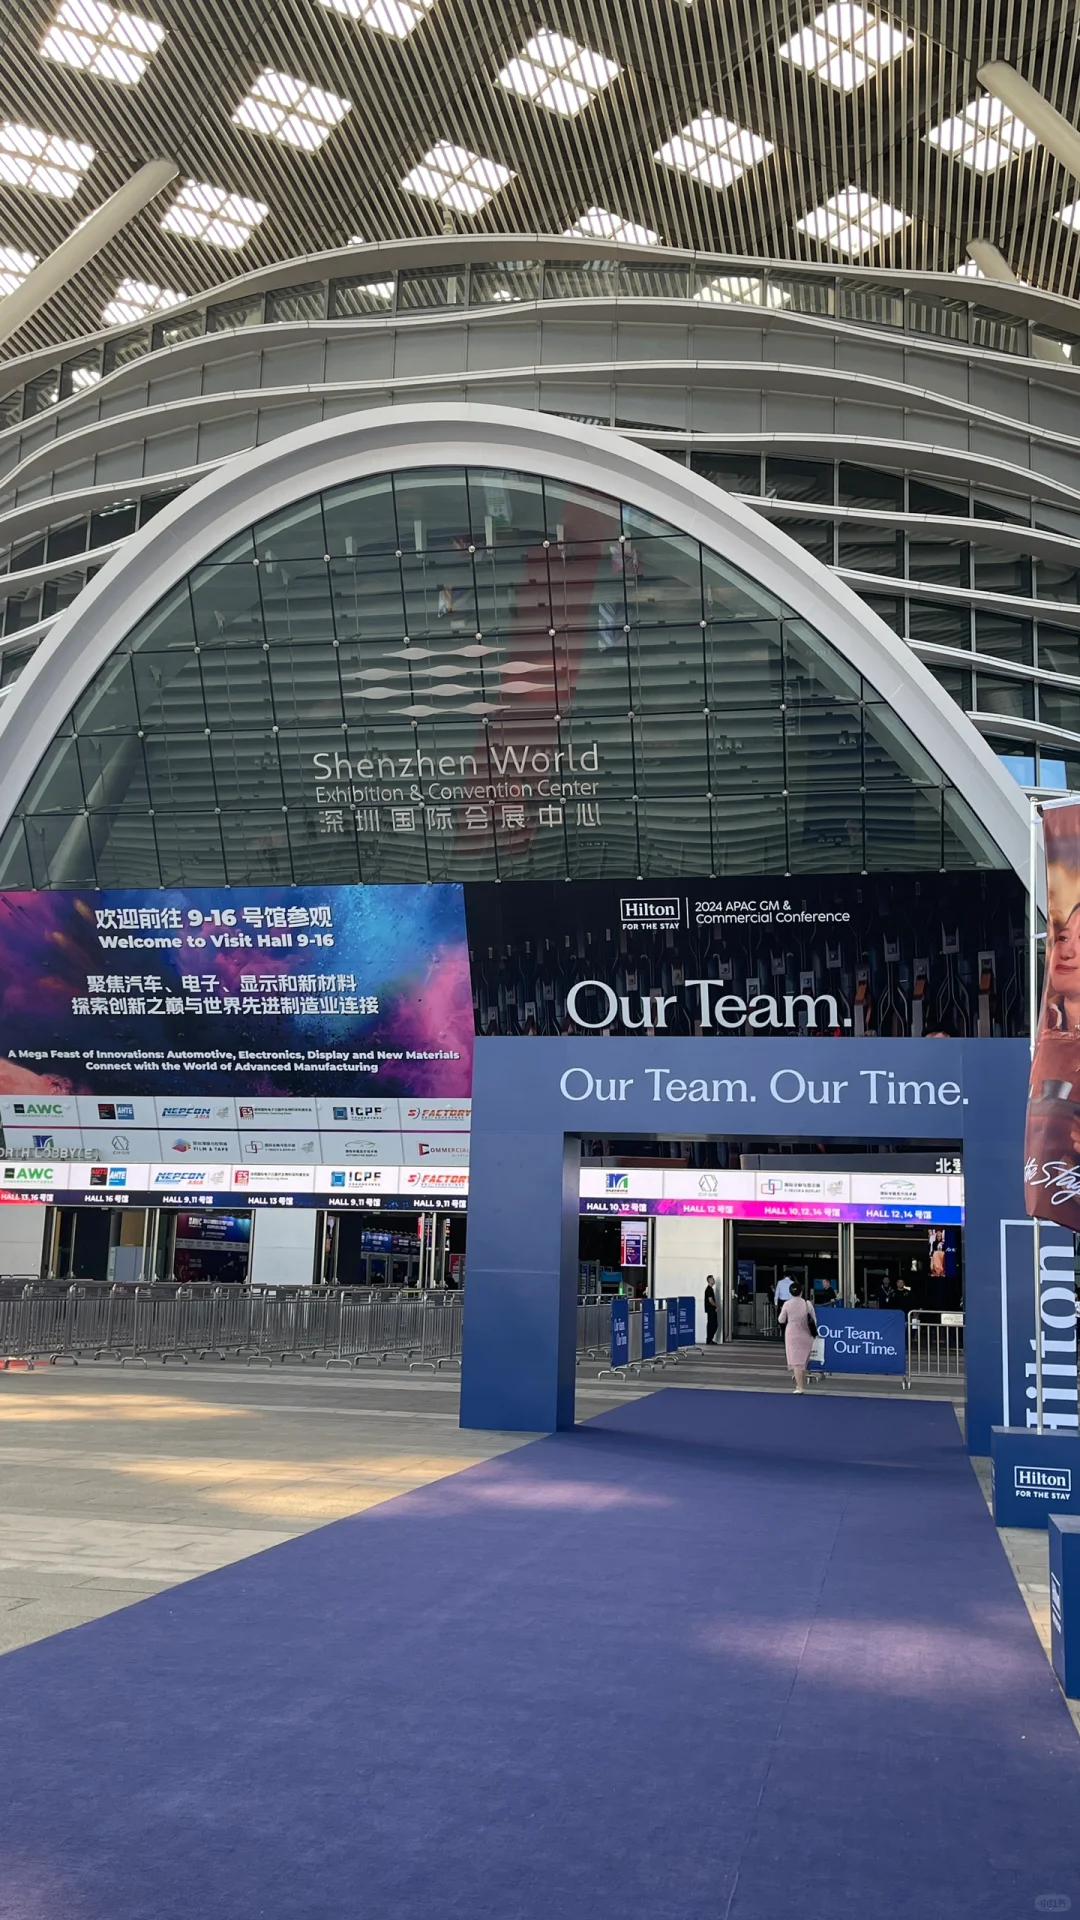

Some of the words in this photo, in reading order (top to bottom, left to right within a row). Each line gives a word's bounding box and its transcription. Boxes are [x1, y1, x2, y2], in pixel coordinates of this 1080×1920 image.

[312, 749, 477, 780] Shenzhen
[491, 743, 599, 774] World
[316, 784, 403, 803] Exhibition
[410, 784, 425, 801] &
[428, 780, 533, 800] Convention
[537, 779, 599, 797] Center
[319, 803, 602, 833] 深圳国际会展中心
[625, 903, 675, 916] Hilton
[695, 902, 723, 912] 2024
[725, 901, 757, 912] APAC
[759, 901, 780, 911] GM
[782, 900, 791, 911] &
[95, 908, 183, 929] 欢迎前往
[188, 909, 237, 927] 9-16
[242, 906, 333, 928] 号馆参观
[696, 912, 773, 924] Commercial
[777, 911, 850, 923] Conference
[98, 935, 183, 949] Welcome
[187, 936, 206, 948] to
[210, 933, 253, 948] Visit
[257, 933, 293, 948] Hall
[296, 934, 334, 948] 9-16
[86, 974, 357, 994] 聚焦汽车、电子、显示和新材料
[71, 996, 379, 1016] 探索创新之巅与世界先进制造业连接
[566, 980, 677, 1028] Our
[684, 979, 852, 1028] Team.
[8, 1050, 17, 1058] A
[18, 1050, 48, 1060] Mega
[50, 1050, 80, 1059] Feast
[82, 1049, 94, 1059] of
[96, 1050, 165, 1059] Innovations:
[166, 1050, 236, 1060] Automotive,
[238, 1050, 305, 1060] Electronics,
[307, 1050, 350, 1061] Display
[352, 1050, 374, 1060] and
[377, 1051, 403, 1060] New
[405, 1050, 460, 1060] Materials
[85, 1062, 132, 1070] Connect
[134, 1061, 160, 1071] with
[161, 1061, 181, 1071] the
[183, 1061, 218, 1071] World
[219, 1061, 233, 1071] of
[234, 1062, 291, 1071] Advanced
[294, 1062, 378, 1073] Manufacturing
[560, 1067, 634, 1101] Our
[644, 1068, 756, 1102] Team.
[770, 1069, 848, 1104] Our
[859, 1070, 968, 1105] Time.
[26, 1104, 63, 1114] AWC
[162, 1107, 211, 1116] NEPCON
[16, 1168, 54, 1179] AWC
[154, 1172, 206, 1184] NEPCON
[422, 1175, 469, 1183] FACTOR
[1, 1193, 20, 1201] HALL
[39, 1193, 54, 1201] 号馆
[84, 1194, 104, 1202] HALL
[105, 1195, 114, 1203] 16
[114, 1195, 129, 1203] 号馆
[198, 1195, 213, 1204] 号馆
[269, 1197, 277, 1205] 13
[278, 1196, 294, 1205] 号馆
[328, 1198, 350, 1206] HALL
[365, 1198, 381, 1207] 号馆
[413, 1199, 434, 1207] HALL
[451, 1199, 467, 1209] 号馆
[586, 1202, 609, 1211] HALL
[631, 1203, 647, 1212] 号馆
[683, 1205, 706, 1213] HALL
[707, 1205, 716, 1213] 12
[717, 1205, 733, 1214] 号馆
[764, 1207, 788, 1215] HALL
[823, 1207, 841, 1218] 号馆
[866, 1209, 889, 1218] HALL
[914, 1210, 932, 1220] 号馆
[817, 1325, 844, 1338] Our
[845, 1326, 883, 1340] Team.
[834, 1340, 861, 1354] Our
[862, 1342, 897, 1355] Time.
[1019, 1471, 1067, 1487] Hilton
[1015, 1490, 1031, 1498] FOR
[1033, 1491, 1049, 1499] THE
[1051, 1492, 1071, 1500] STAY
